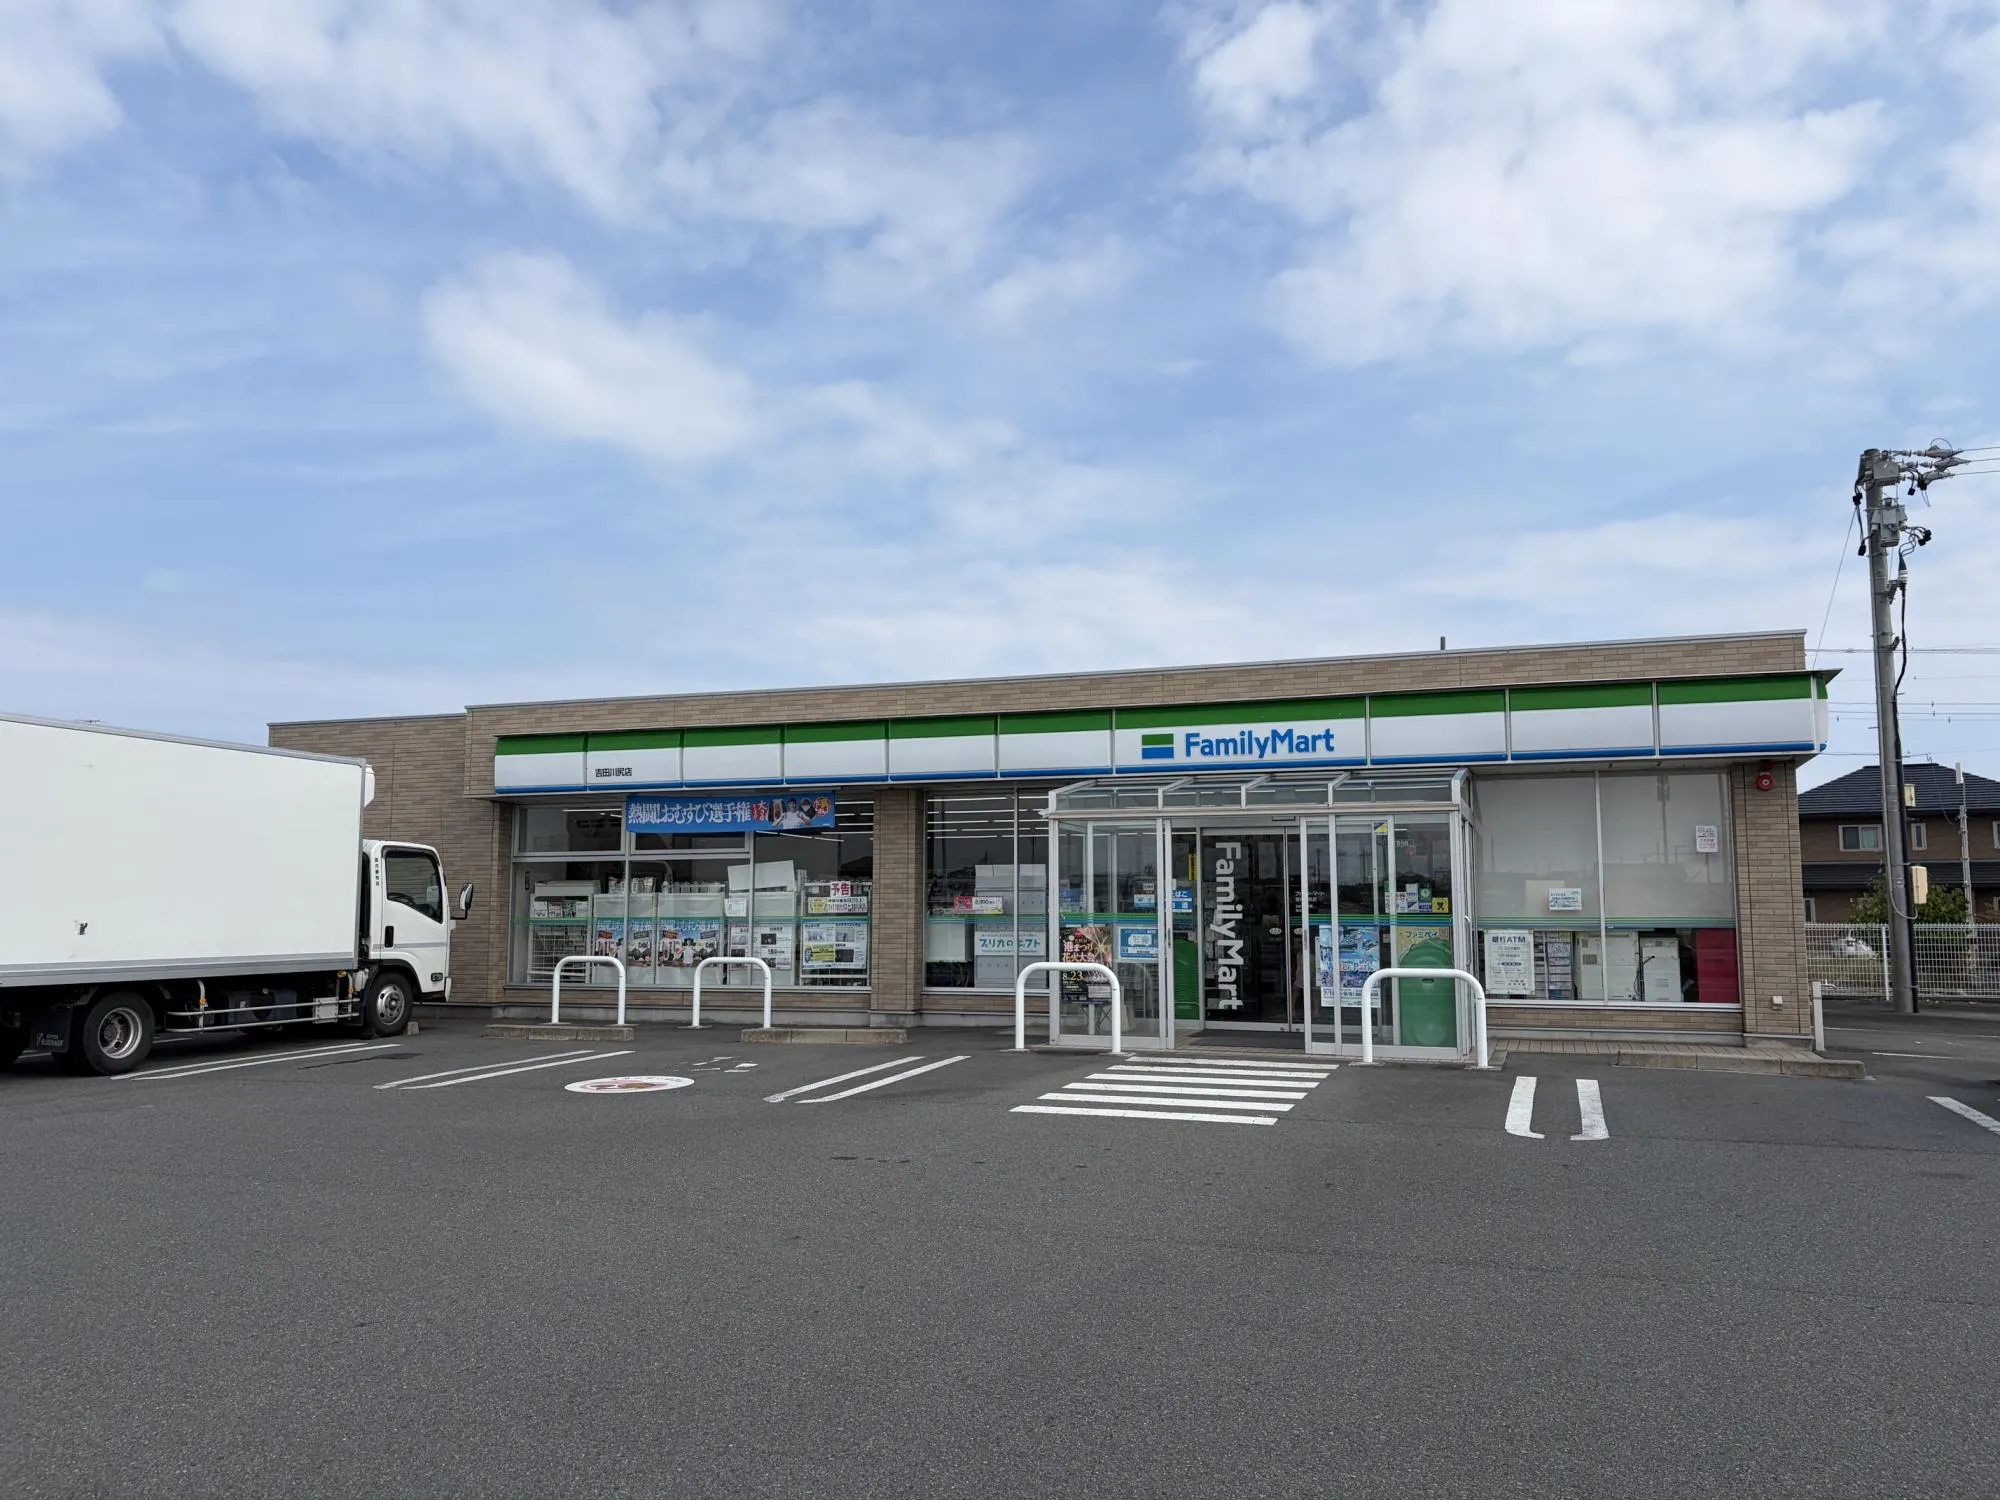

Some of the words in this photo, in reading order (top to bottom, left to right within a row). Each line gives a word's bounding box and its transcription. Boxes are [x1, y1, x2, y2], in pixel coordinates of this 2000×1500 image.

[1185, 728, 1335, 759] FamilyMart
[831, 882, 850, 896] 予告
[1209, 842, 1244, 1010] FamilyMart
